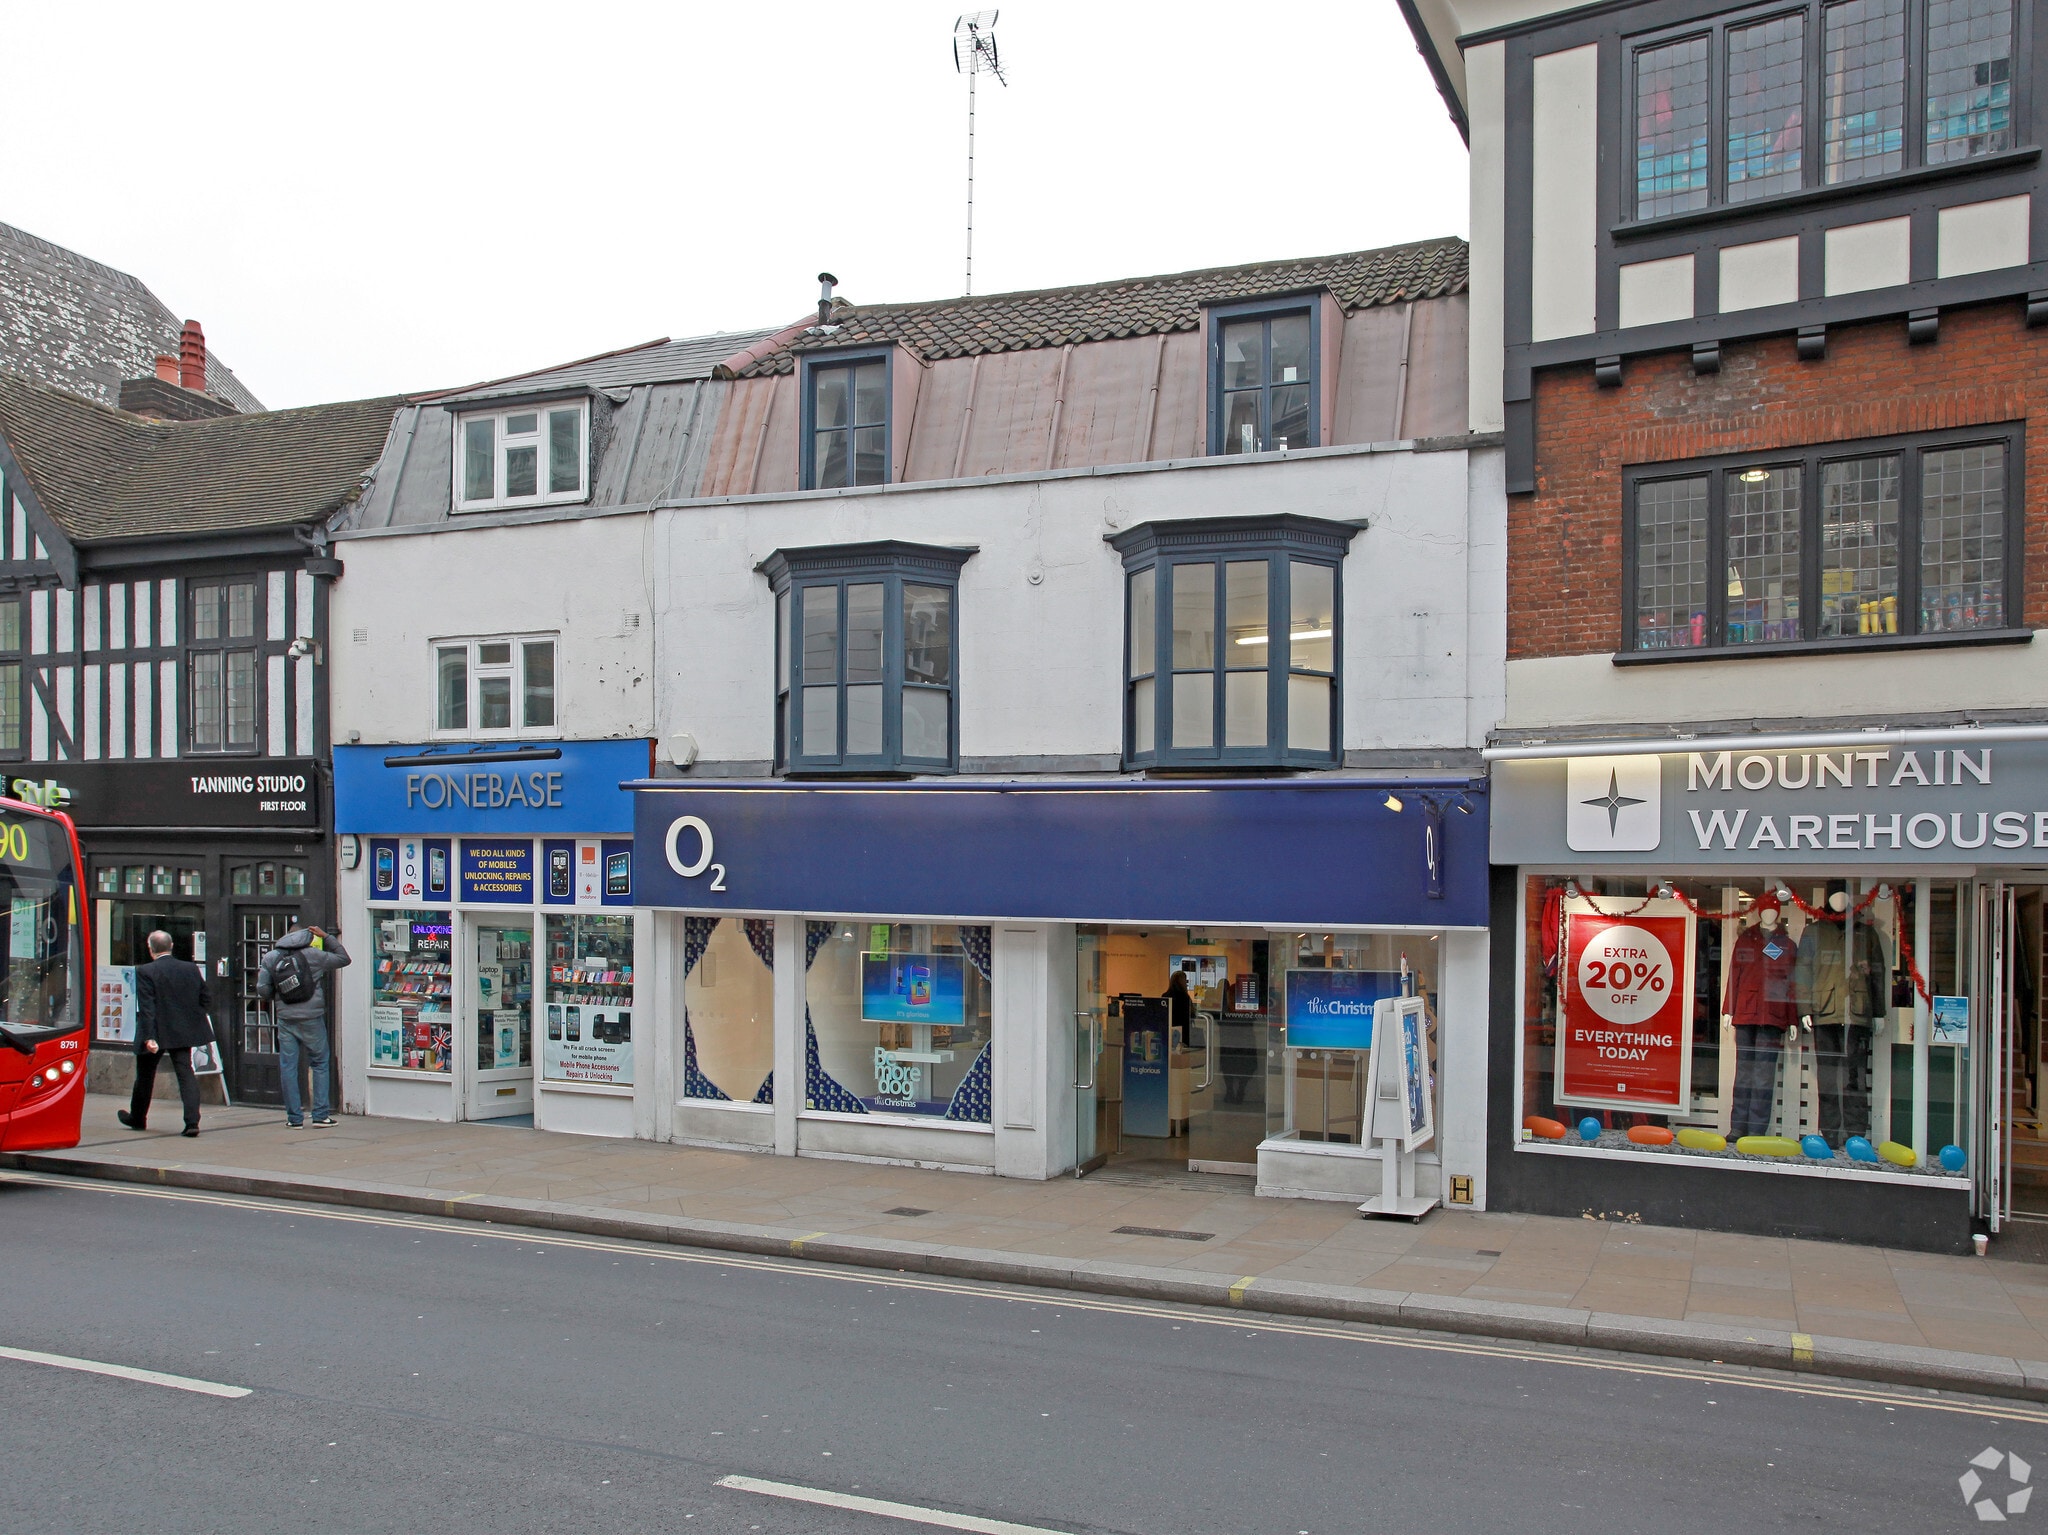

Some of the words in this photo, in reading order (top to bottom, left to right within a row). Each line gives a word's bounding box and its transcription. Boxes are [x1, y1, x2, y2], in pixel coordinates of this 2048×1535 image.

[1687, 748, 1992, 791] MOUNTAIN
[191, 776, 254, 793] TANNING
[257, 775, 305, 793] STUDIO
[407, 772, 562, 808] FONEBASE
[260, 801, 279, 811] FIRST
[280, 801, 306, 811] FLOOR
[294, 845, 303, 853] 44
[406, 843, 415, 859] 3
[470, 849, 480, 857] WE
[481, 849, 491, 857] DO
[506, 849, 526, 857] KINDS
[665, 815, 726, 891] O2
[488, 861, 517, 869] MOBILES
[465, 872, 504, 881] UNLOCKING,
[505, 872, 531, 880] REPAIRS
[473, 883, 478, 891] &
[480, 883, 522, 892] ACCESSORIES
[412, 925, 453, 934] UNLOCKING
[427, 933, 437, 941] &
[418, 940, 449, 949] REPAIR
[1604, 947, 1648, 959] EXTRA
[479, 966, 498, 975] Laptop
[1585, 961, 1665, 992] 20%
[1611, 993, 1638, 1005] OFF
[1307, 997, 1328, 1014] this
[1328, 1001, 1375, 1015] Christm
[1575, 1029, 1672, 1047] EVERYTHING
[60, 1041, 78, 1049] 8791
[875, 1047, 896, 1066] Be
[1597, 1045, 1649, 1061] TODAY
[560, 1061, 575, 1069] Mobile
[592, 1063, 619, 1071] Accessories
[566, 1070, 583, 1078] Repairs
[590, 1072, 613, 1081] Unlocking
[875, 1065, 921, 1082] more
[878, 1074, 914, 1100] dog
[885, 1098, 916, 1107] Christmas
[1453, 1178, 1469, 1200] H
